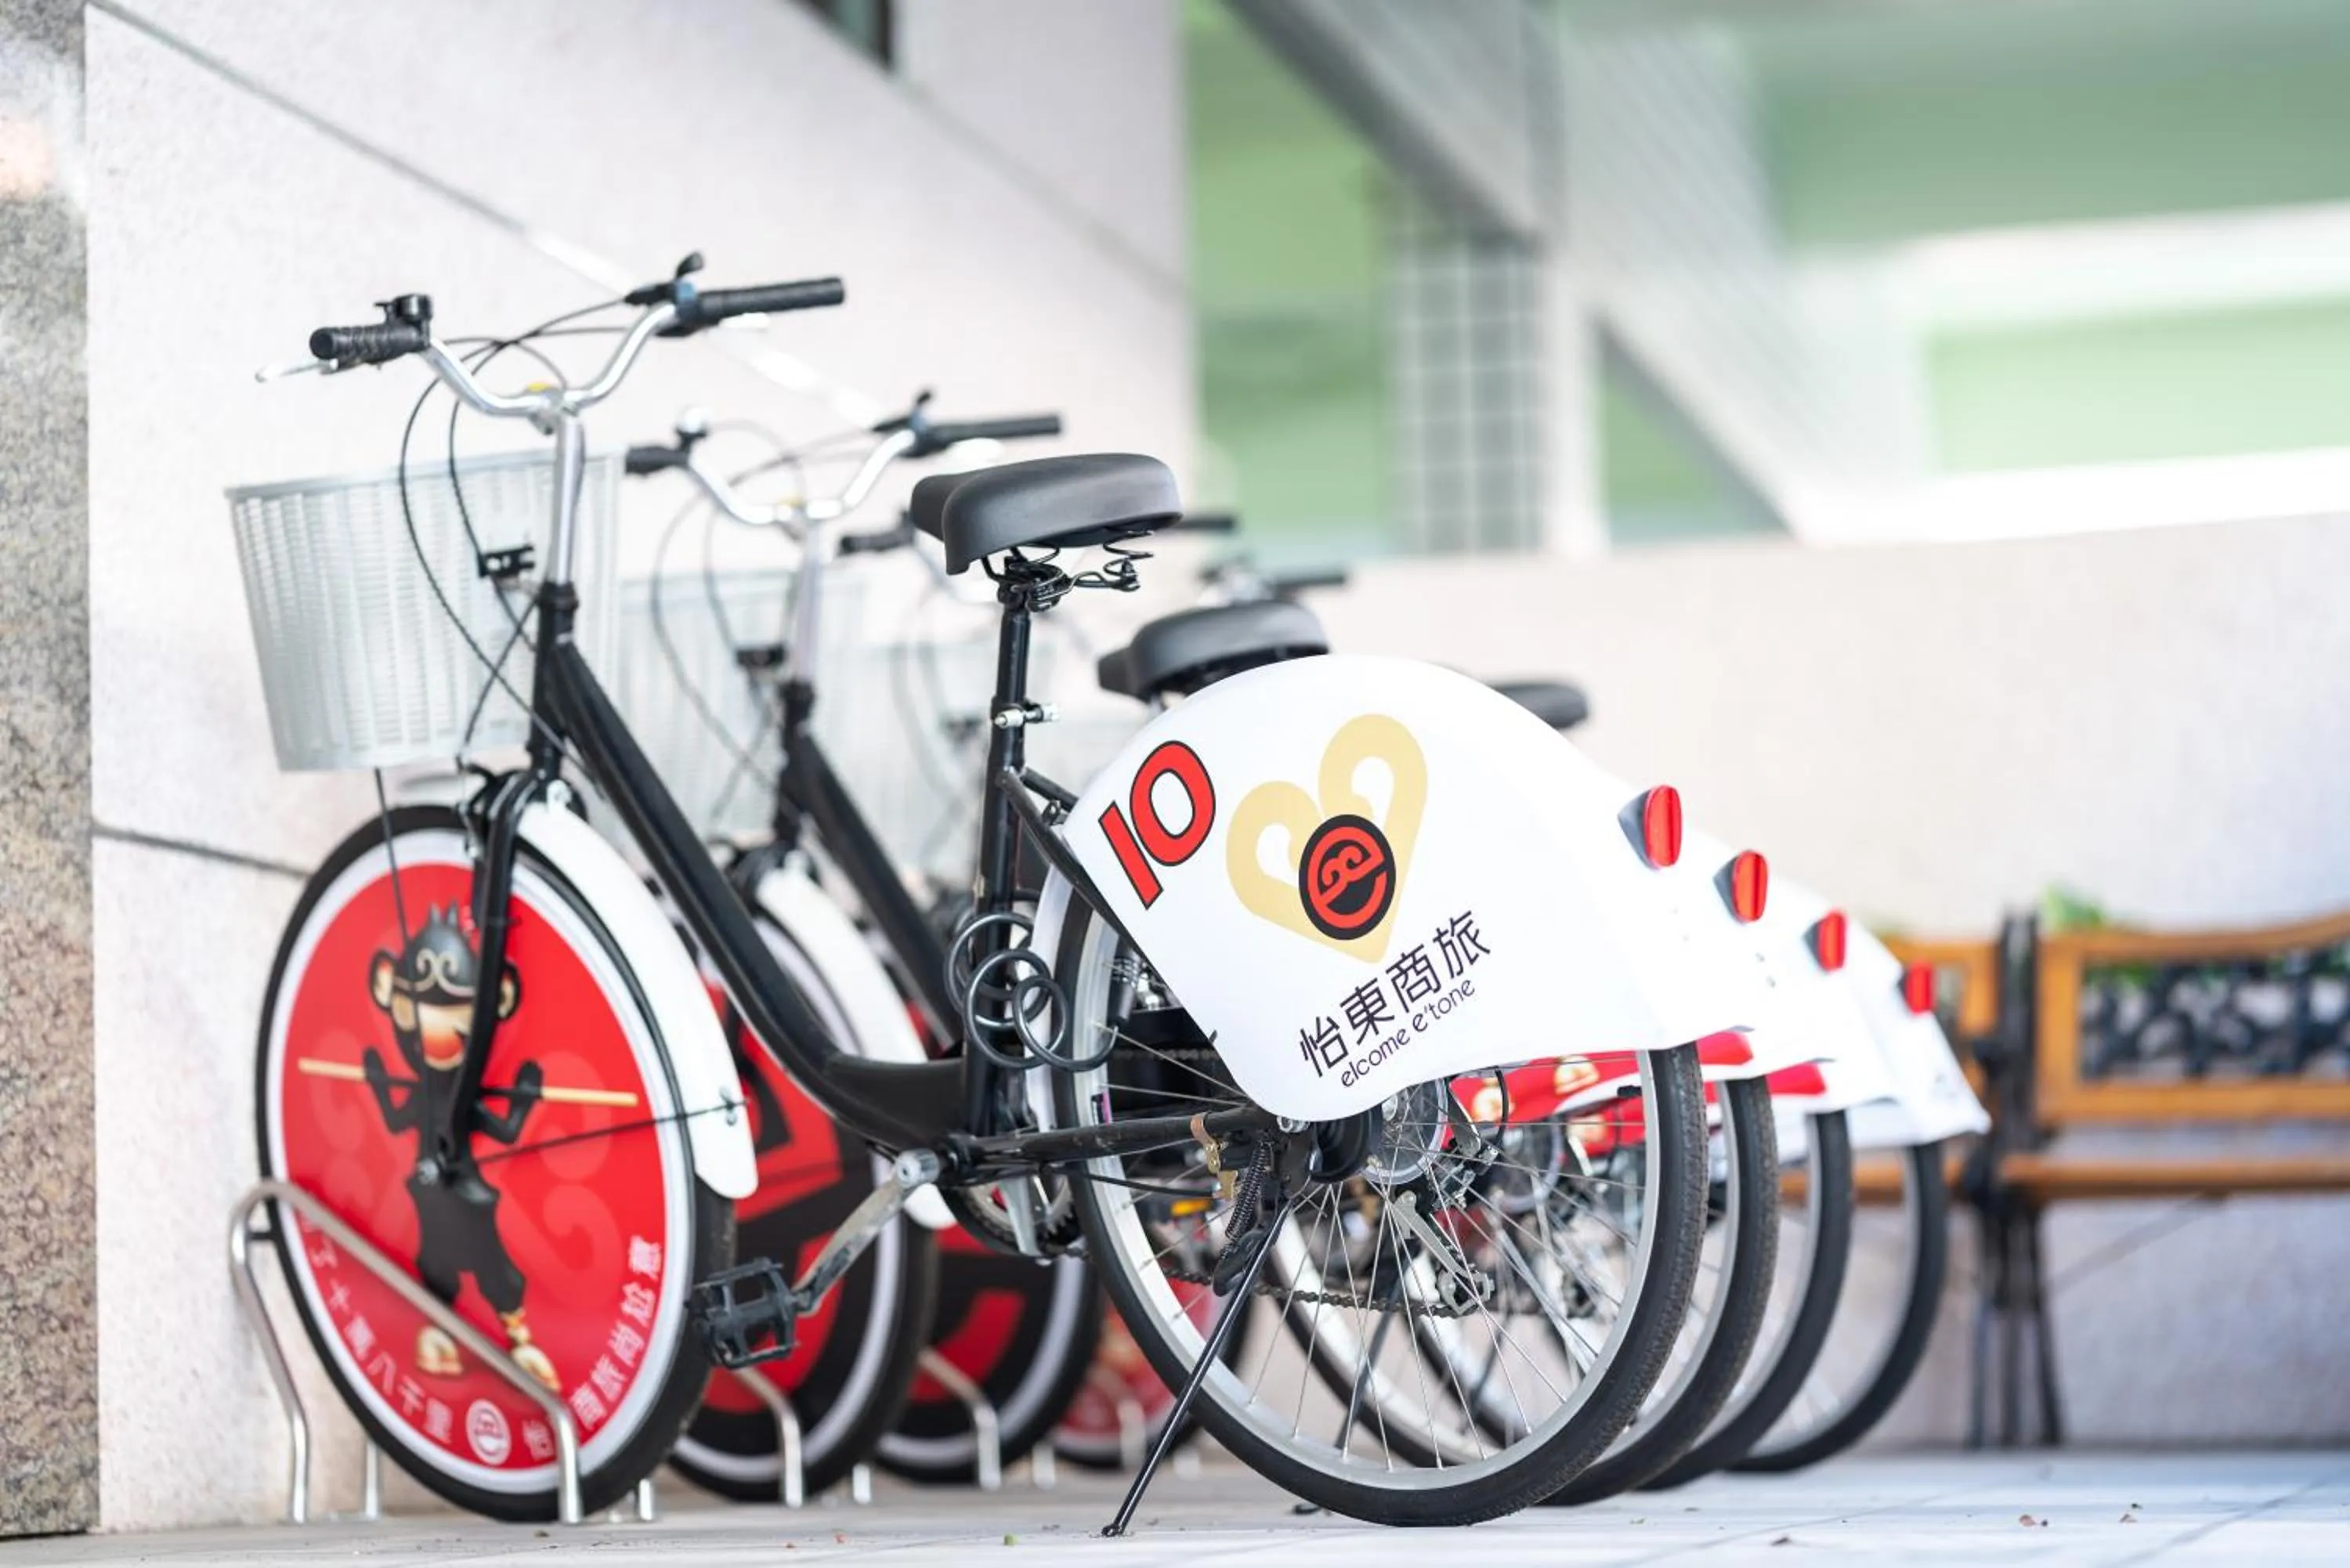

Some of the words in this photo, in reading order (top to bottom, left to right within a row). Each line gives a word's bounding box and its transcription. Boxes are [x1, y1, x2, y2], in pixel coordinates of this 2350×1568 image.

[1097, 740, 1216, 910] 10
[1300, 910, 1491, 1078] 怡東商旅
[1341, 1028, 1411, 1087] elcome
[1412, 980, 1475, 1032] e'tone
